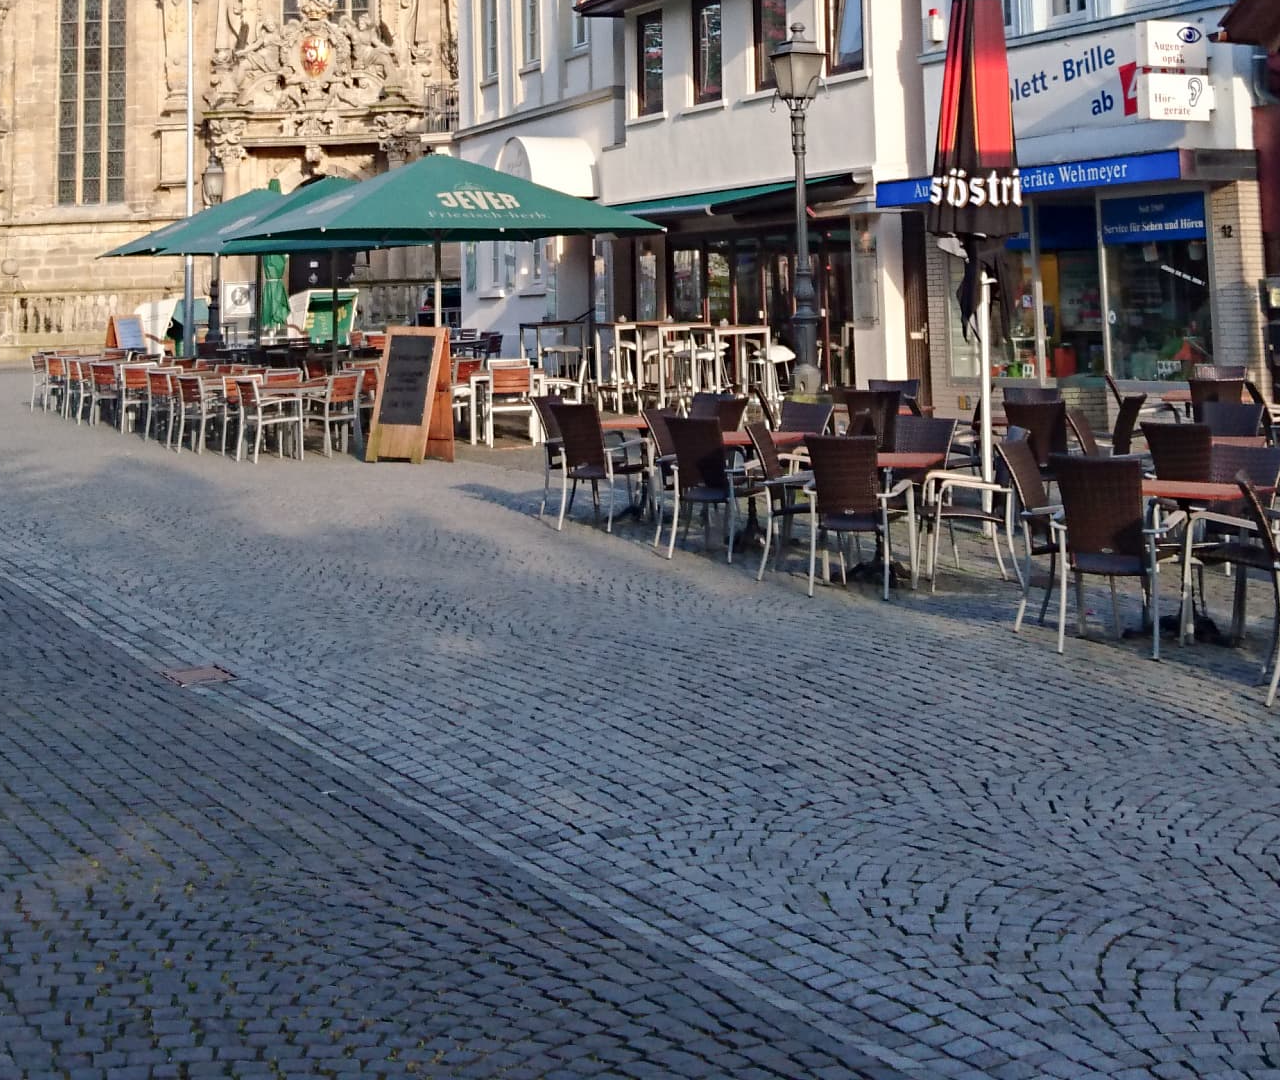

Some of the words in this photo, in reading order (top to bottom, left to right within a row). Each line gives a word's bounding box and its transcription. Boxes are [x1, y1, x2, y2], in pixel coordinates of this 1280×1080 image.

[1010, 72, 1049, 103] lett
[1062, 45, 1116, 84] Brille
[1091, 90, 1115, 116] ab
[1058, 161, 1128, 185] Wehmeyer
[436, 190, 521, 210] JEVER
[1222, 225, 1233, 238] 12
